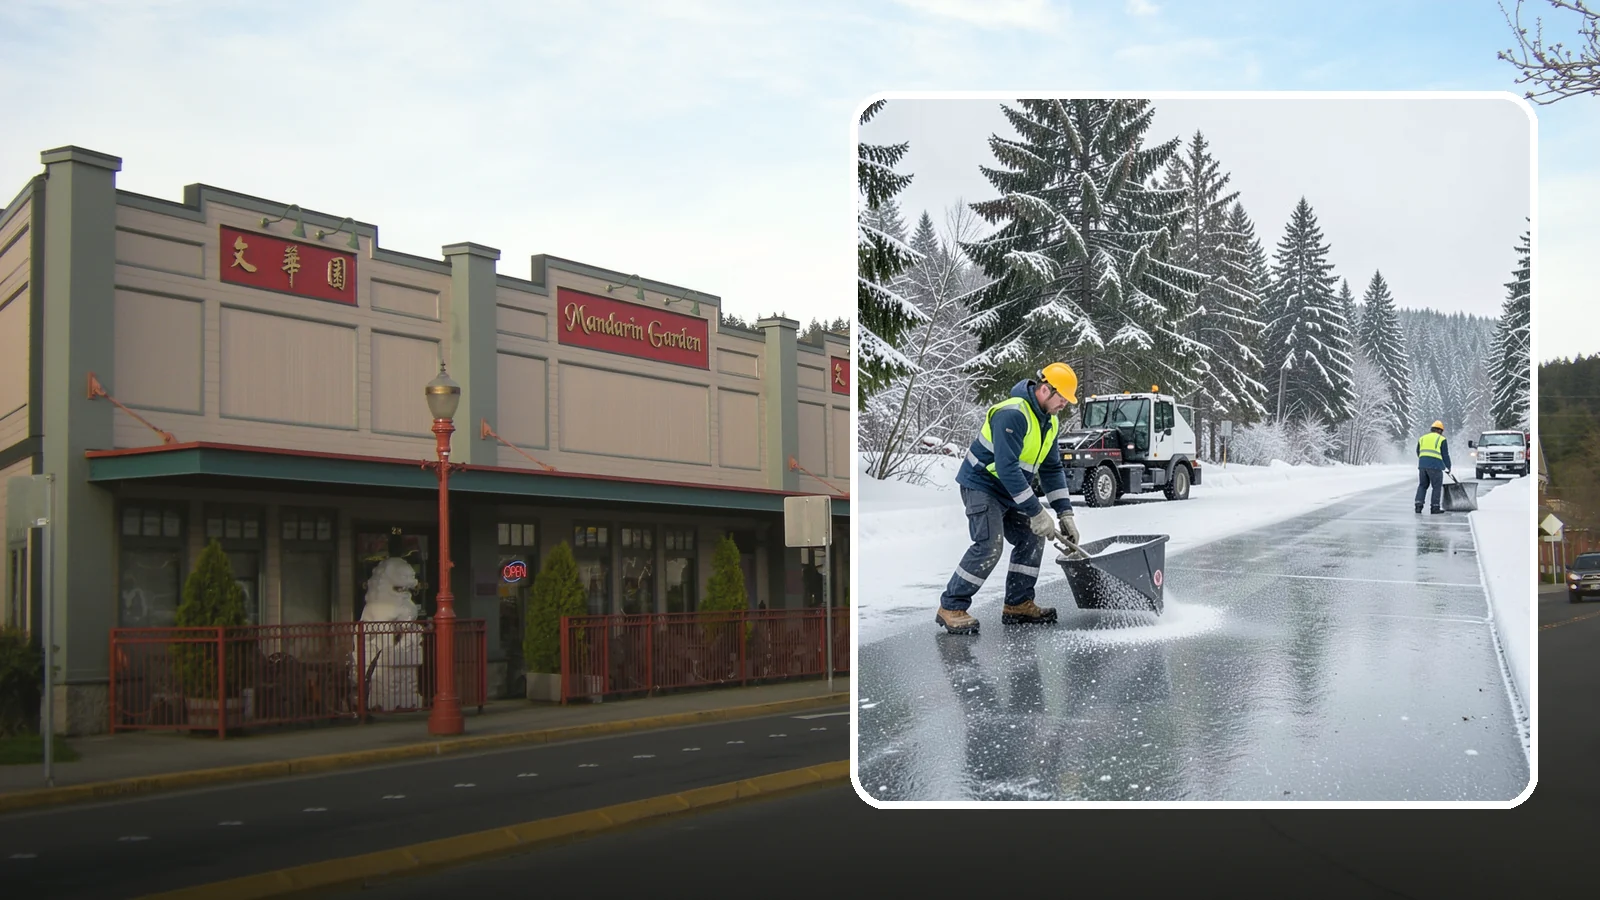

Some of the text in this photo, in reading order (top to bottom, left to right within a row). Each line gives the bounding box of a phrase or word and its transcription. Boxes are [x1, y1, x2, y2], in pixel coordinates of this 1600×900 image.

[231, 235, 346, 291] 文華園
[564, 302, 702, 352] Mandarin Garden
[503, 565, 527, 578] OPEN
